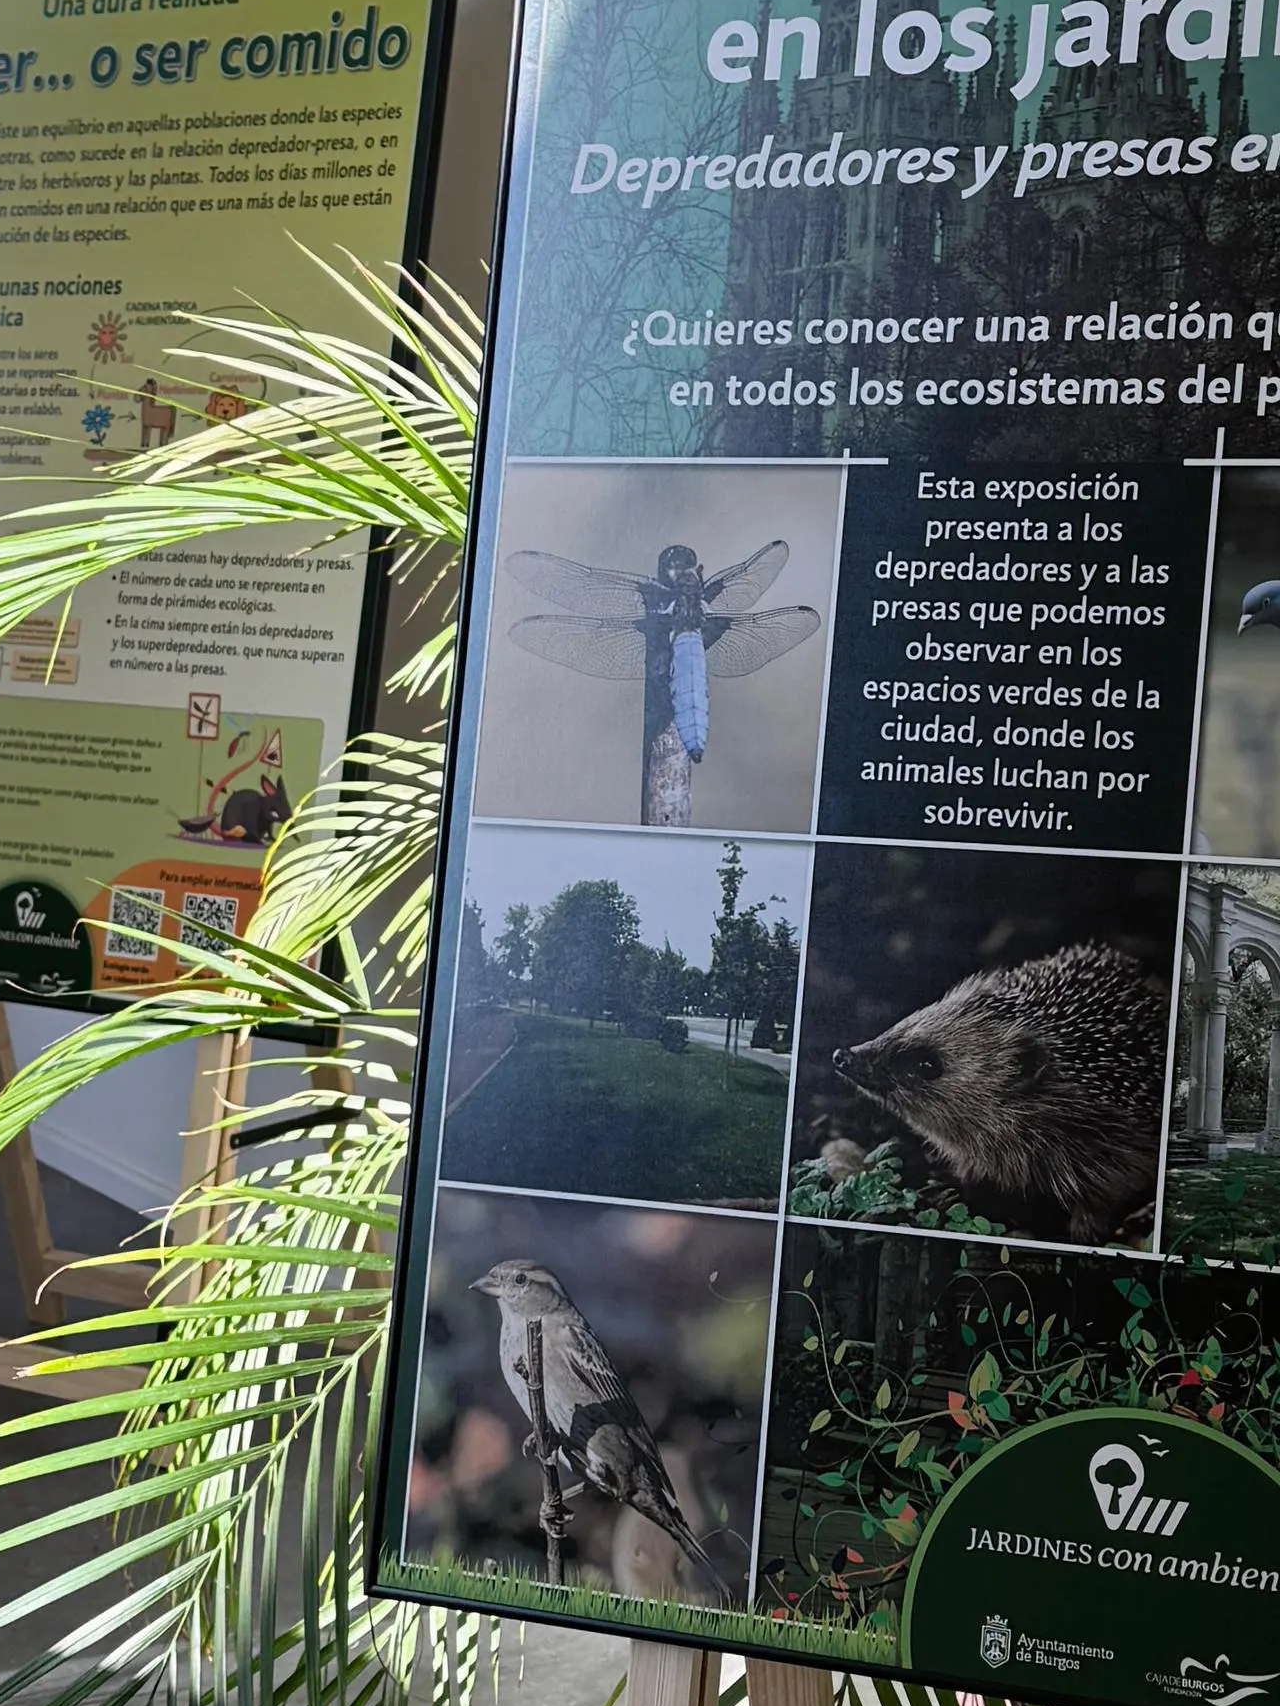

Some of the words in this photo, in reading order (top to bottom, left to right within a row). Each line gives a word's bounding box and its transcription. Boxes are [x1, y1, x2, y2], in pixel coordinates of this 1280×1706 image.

[90, 45, 119, 89] o
[131, 38, 211, 87] ser
[220, 9, 412, 81] comido
[706, 14, 821, 86] en
[340, 103, 403, 122] especies
[570, 128, 957, 209] Depredadores
[960, 144, 1007, 199] y
[1015, 131, 1218, 199] presas
[43, 279, 123, 297] nociones
[622, 307, 793, 358] ¿Quieres
[804, 310, 966, 347] conocer
[974, 315, 1050, 343] una
[1064, 300, 1233, 341] relación
[669, 380, 714, 407] en
[725, 367, 839, 415] todos
[848, 366, 905, 406] los
[915, 367, 1166, 406] ecosistemas
[1178, 363, 1245, 404] del
[917, 471, 975, 499] Esta
[984, 472, 1138, 508] exposición
[925, 517, 1048, 548] presenta
[1057, 522, 1073, 541] a
[1083, 514, 1123, 542] los
[874, 552, 1072, 588] depredadores
[1078, 563, 1098, 591] y
[1105, 564, 1121, 583] a
[1131, 556, 1170, 584] las
[871, 599, 961, 627] presas
[969, 602, 1023, 630] que
[1030, 597, 1165, 631] podemos
[905, 634, 1032, 663] observar
[1038, 645, 1072, 665] en
[1082, 638, 1122, 666] los
[862, 680, 981, 708] espacios
[988, 678, 1083, 707] verdes
[1091, 680, 1127, 708] de
[1136, 681, 1160, 709] la
[880, 716, 983, 748] ciudad,
[993, 718, 1085, 748] donde
[1094, 721, 1134, 750] los
[860, 754, 984, 785] animales
[993, 758, 1088, 790] luchan
[1097, 771, 1148, 799] por
[923, 797, 1073, 831] sobrevivir.
[966, 1527, 1092, 1565] JARDINES
[1097, 1547, 1153, 1574] con
[1015, 1649, 1032, 1663] de
[1035, 1651, 1080, 1671] Burgos
[1017, 1633, 1114, 1660] Ayuntamiento
